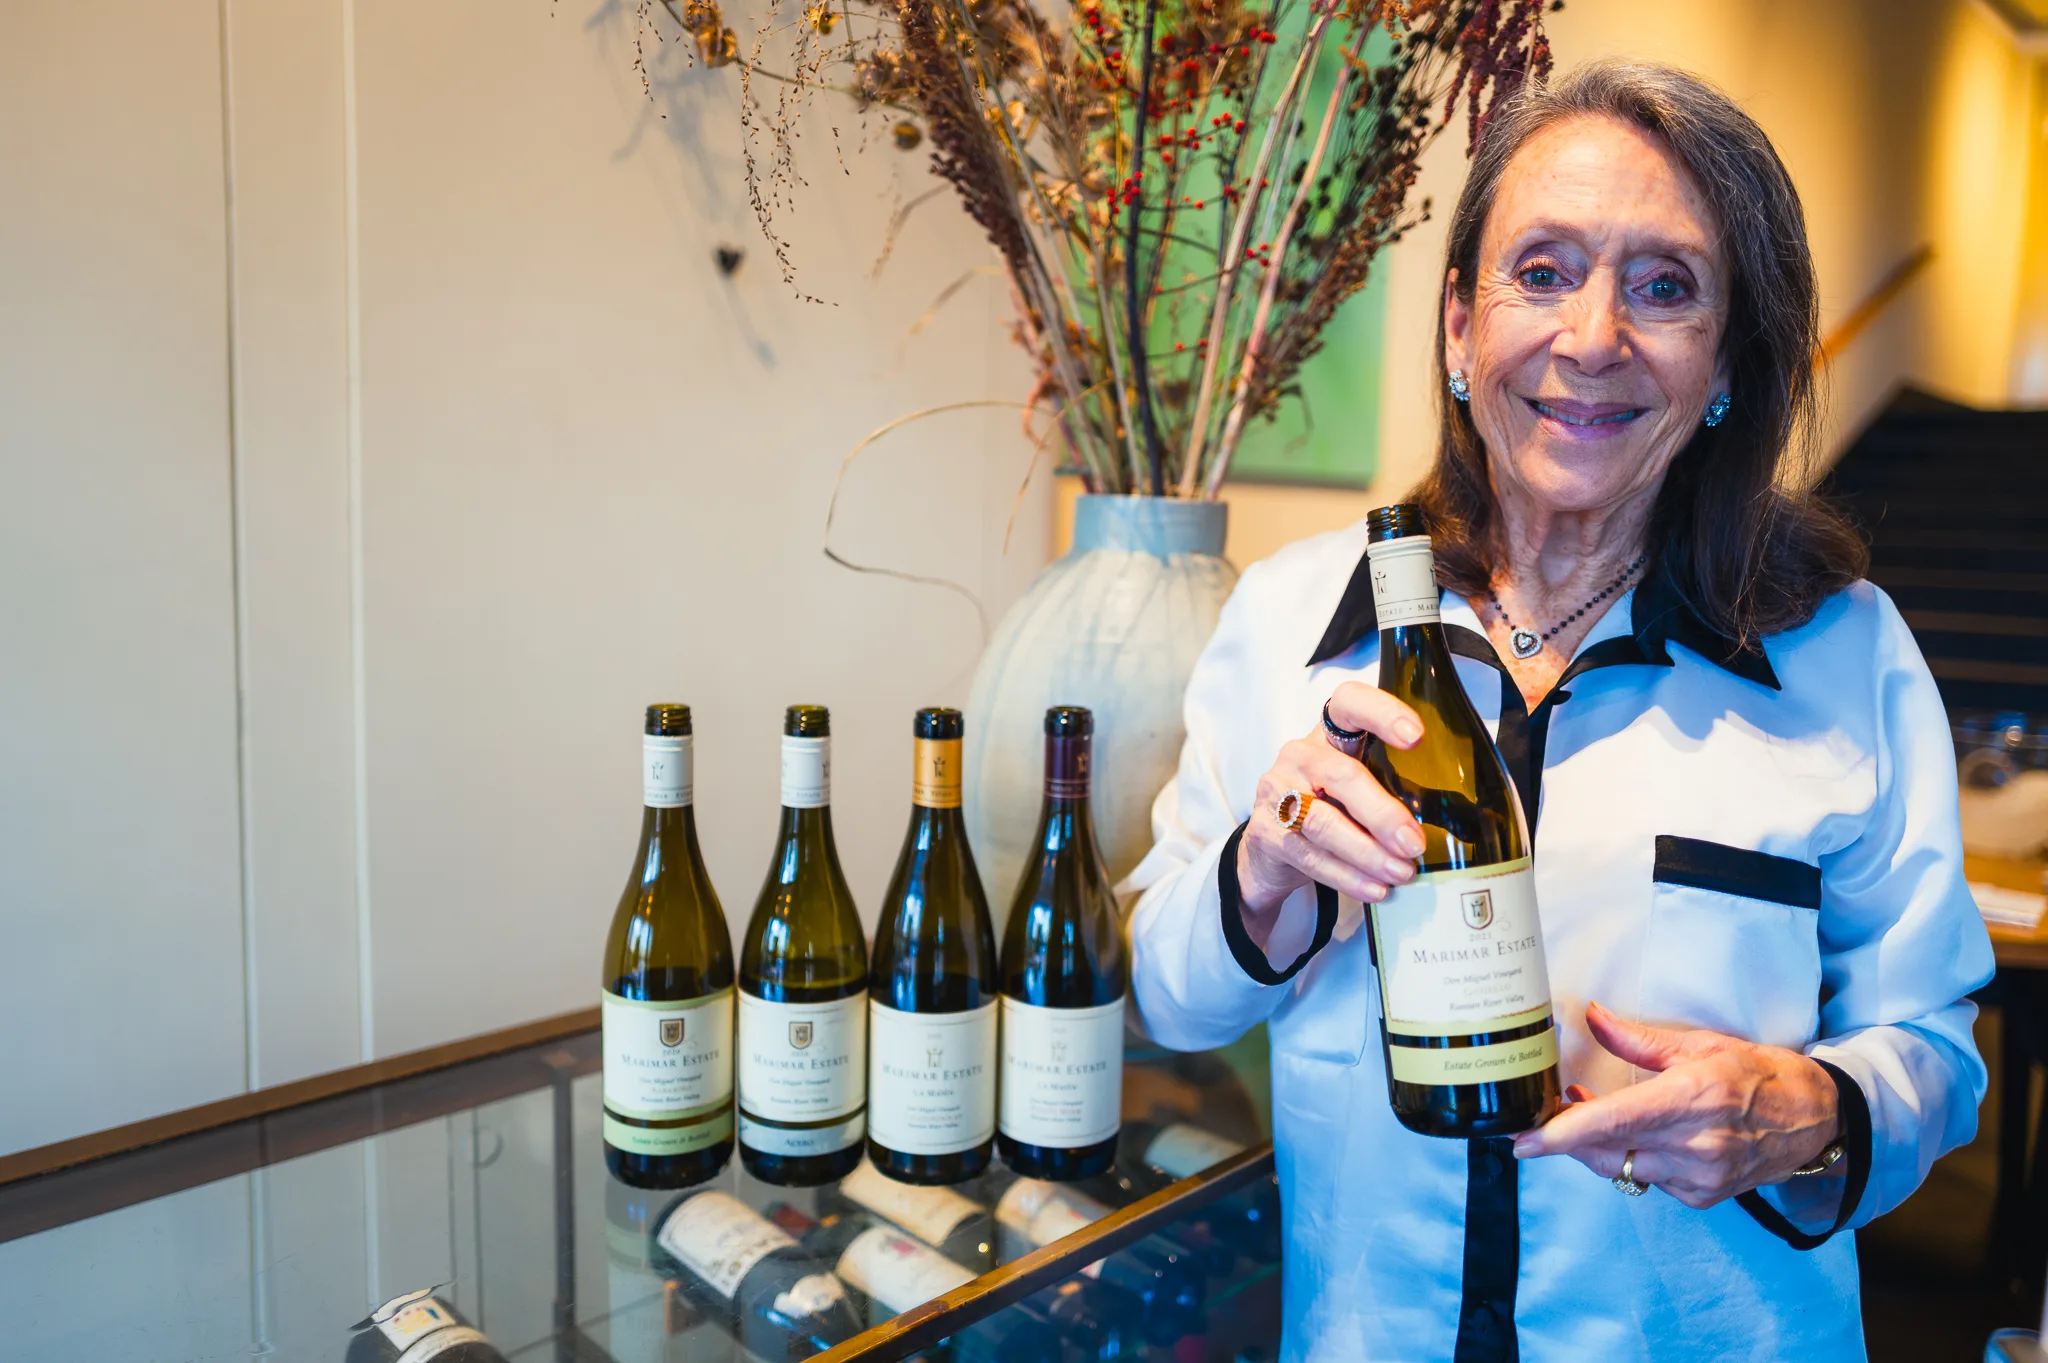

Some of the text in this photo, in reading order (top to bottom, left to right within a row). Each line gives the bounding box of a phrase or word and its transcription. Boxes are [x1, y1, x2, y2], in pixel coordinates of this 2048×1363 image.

[1469, 932, 1492, 942] 2021
[1412, 936, 1538, 965] MARIMAR ESTATE
[621, 1049, 720, 1068] MARIMAR ESTATE
[752, 1052, 850, 1070] MARIMAR ESTATE
[1444, 1046, 1543, 1071] Estate Grown & Bottled
